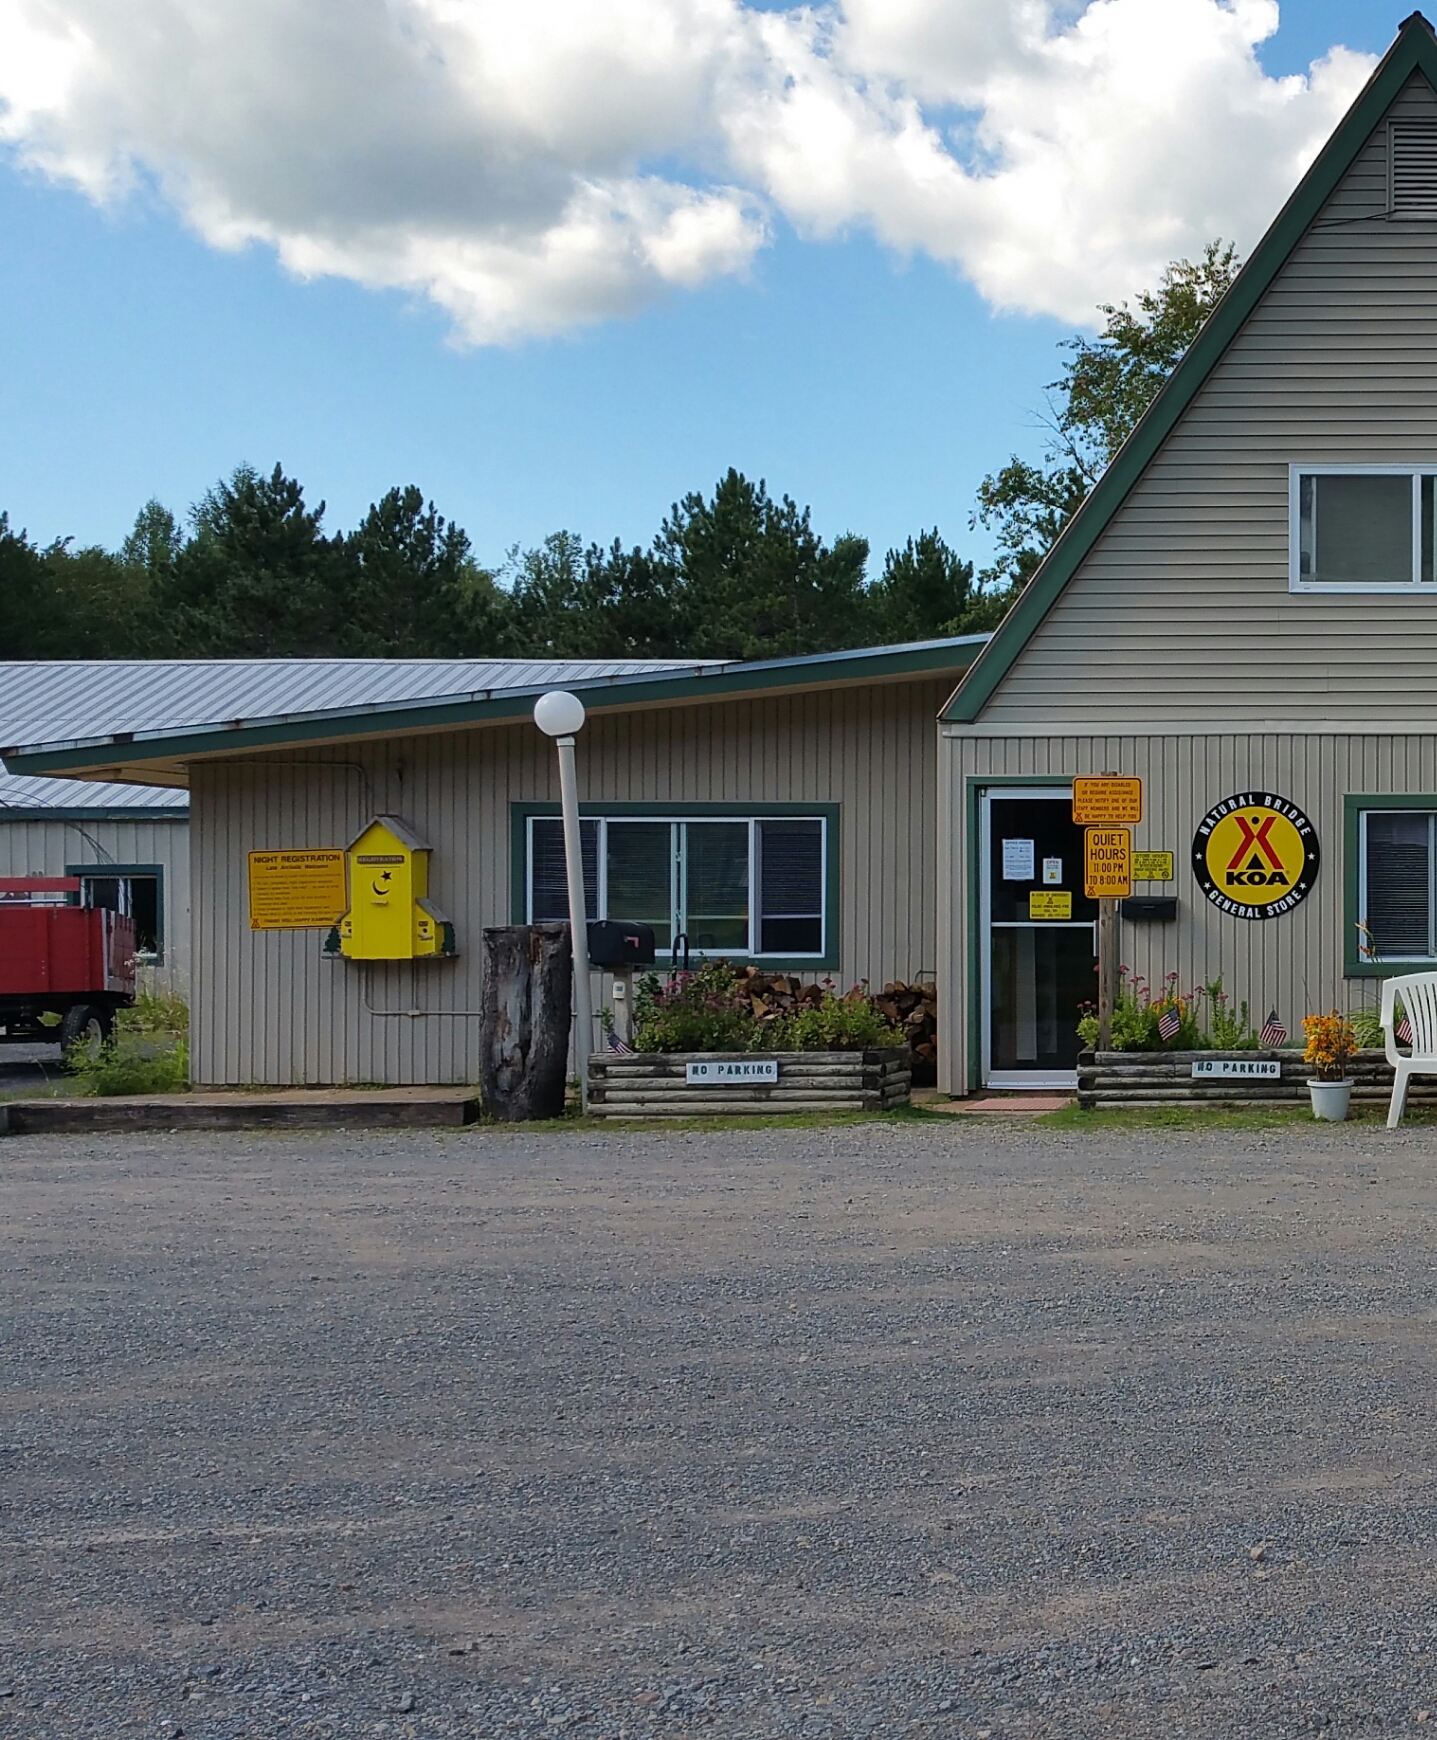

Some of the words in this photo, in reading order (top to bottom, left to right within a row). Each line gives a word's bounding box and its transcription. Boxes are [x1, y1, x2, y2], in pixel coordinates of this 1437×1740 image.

[1199, 794, 1255, 836] NATURAL
[1264, 795, 1311, 836] BRIDGE
[1092, 833, 1123, 846] QUIET
[280, 854, 340, 863] REGISTRATION
[1090, 849, 1126, 860] HOURS
[1094, 863, 1112, 872] 11:00
[1113, 863, 1124, 872] PM
[1089, 875, 1098, 885] TO
[1099, 875, 1117, 885] 8:00
[1118, 875, 1128, 885] AM
[1226, 871, 1291, 886] KOA
[1208, 889, 1261, 918] GENERAL
[1266, 889, 1302, 916] STORE
[692, 1065, 708, 1075] NO
[717, 1065, 772, 1075] PARKING
[1197, 1062, 1213, 1071] NO
[1222, 1063, 1276, 1073] PARKING
